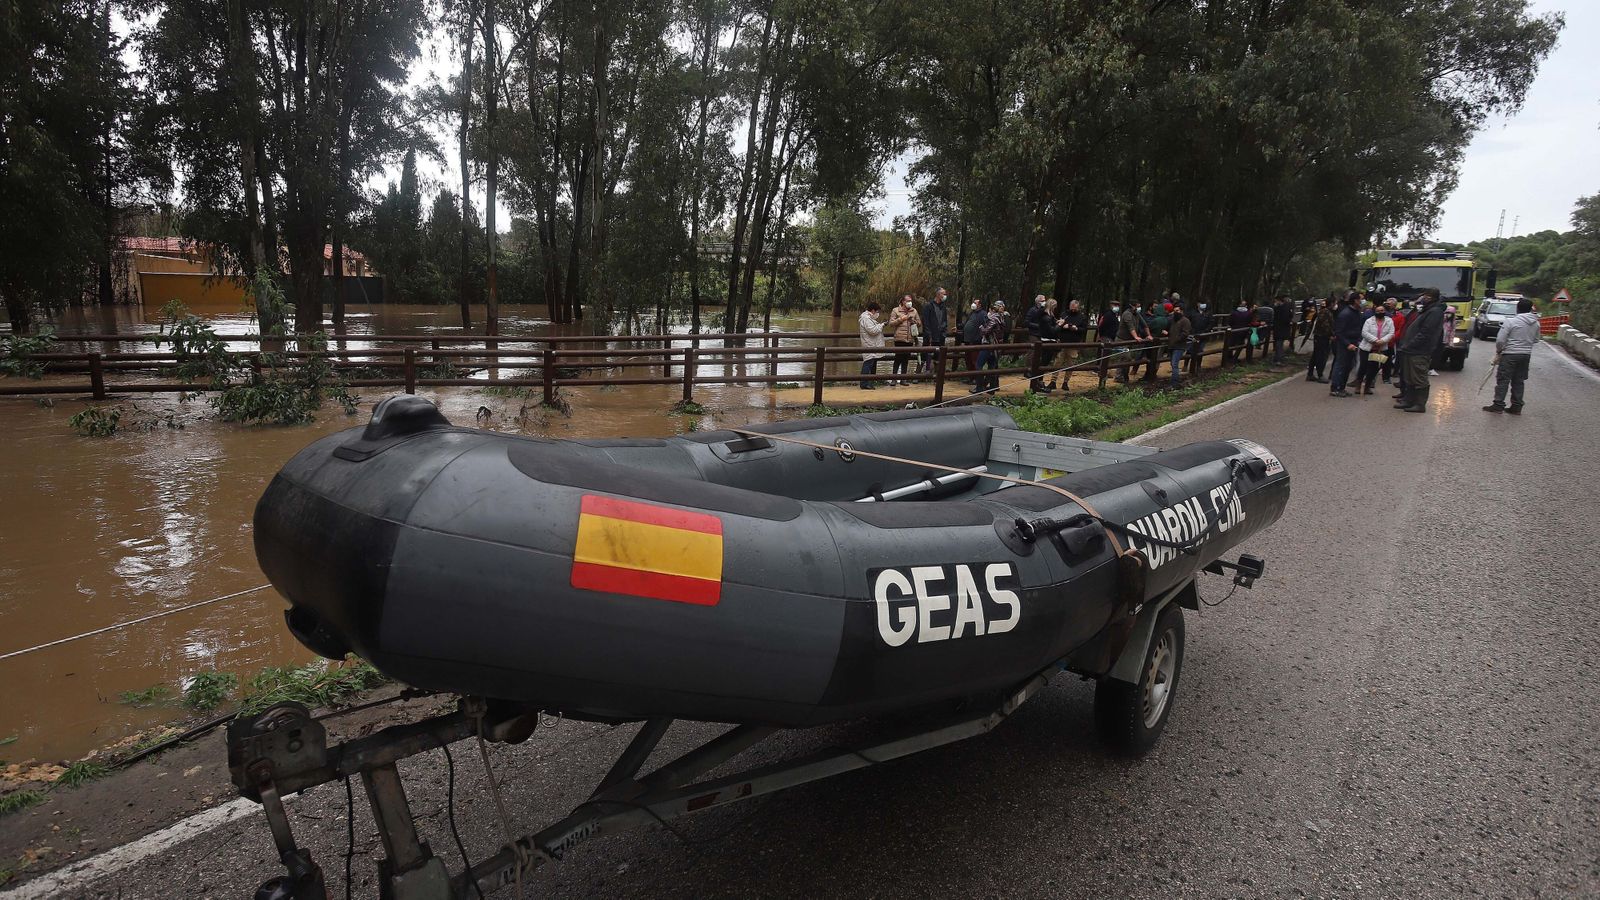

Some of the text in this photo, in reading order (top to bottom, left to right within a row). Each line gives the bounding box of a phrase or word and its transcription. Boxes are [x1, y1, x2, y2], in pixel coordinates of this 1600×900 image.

[1126, 481, 1246, 570] GUARDIA CIVIL
[874, 562, 1021, 647] GEAS
